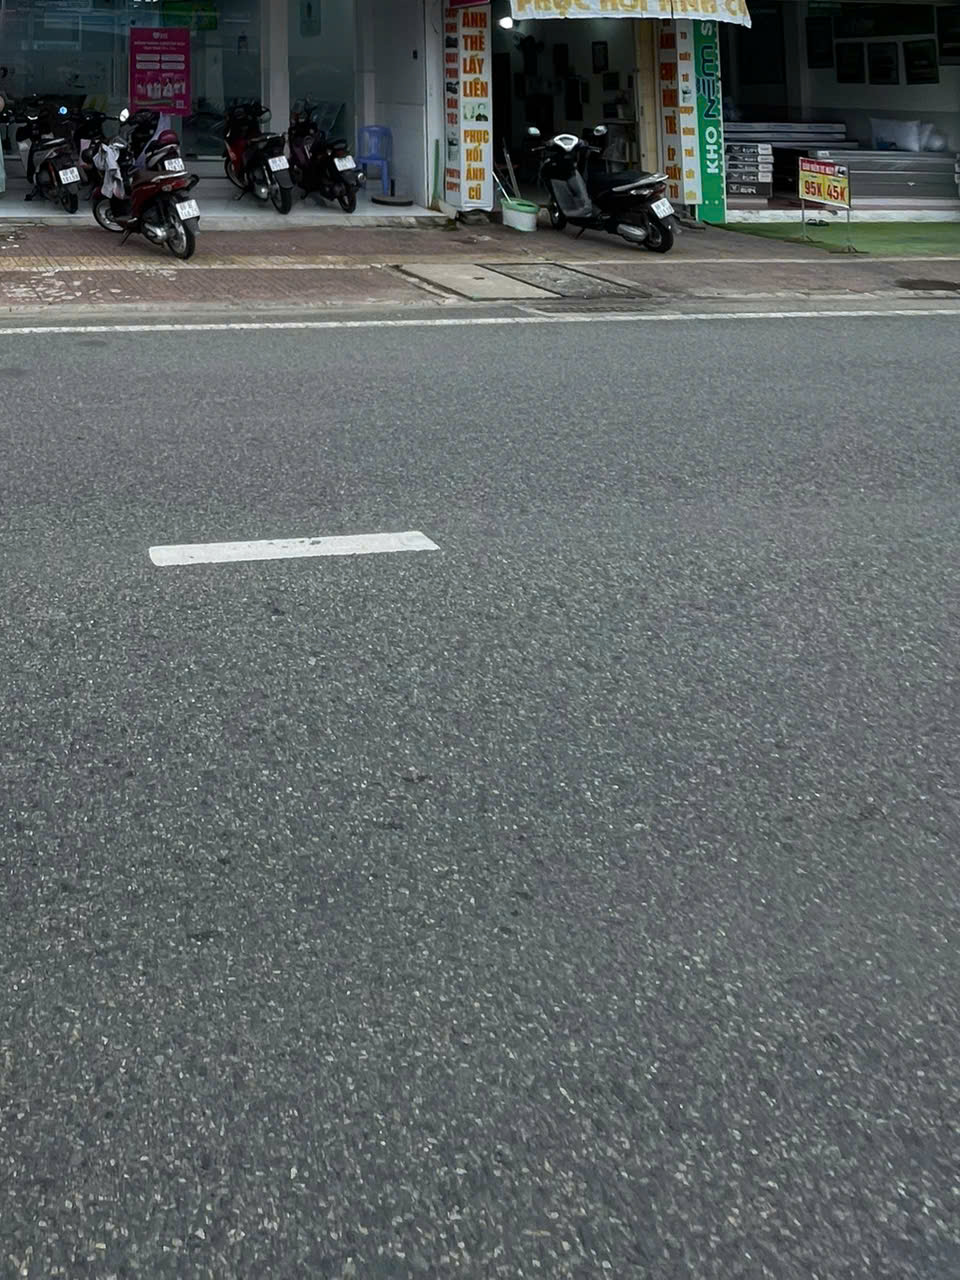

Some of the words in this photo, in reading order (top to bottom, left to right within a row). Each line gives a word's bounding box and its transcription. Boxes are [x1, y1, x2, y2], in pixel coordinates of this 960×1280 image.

[705, 126, 719, 174] KHO
[804, 180, 823, 197] 95K
[827, 184, 846, 201] 45K
